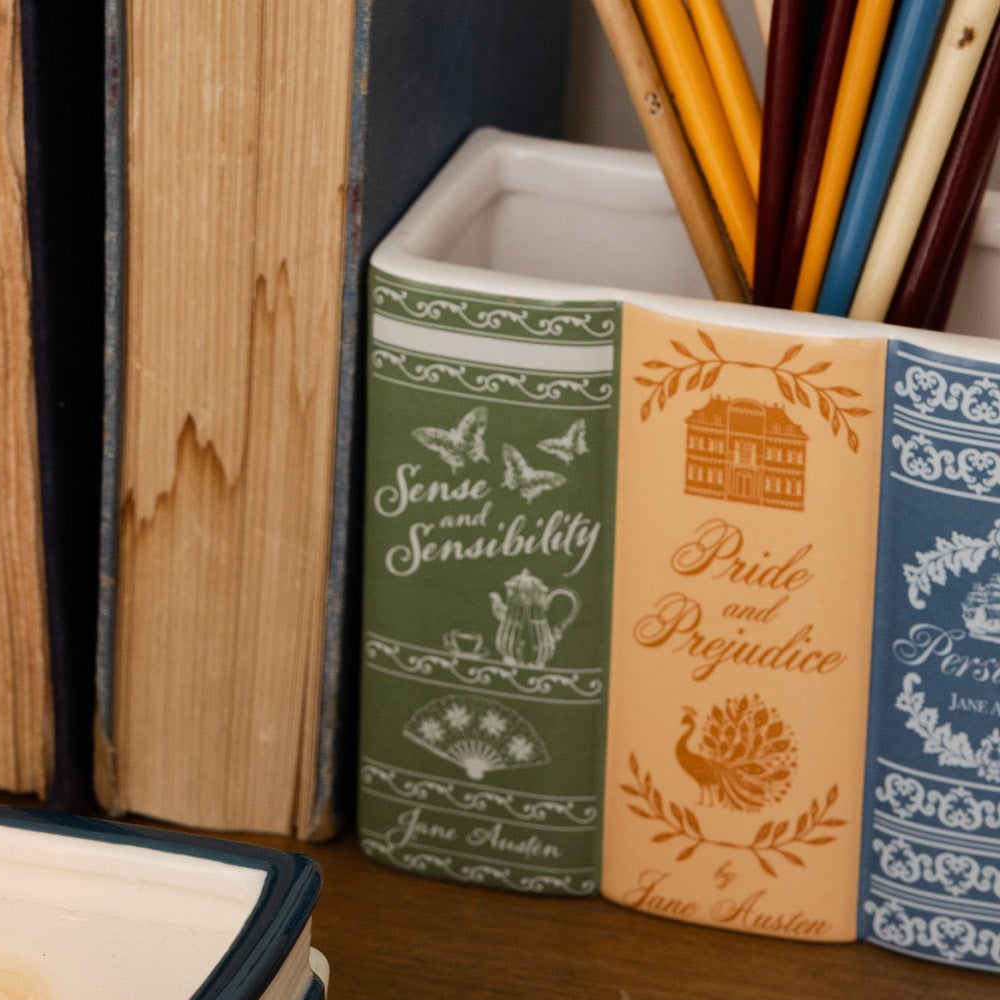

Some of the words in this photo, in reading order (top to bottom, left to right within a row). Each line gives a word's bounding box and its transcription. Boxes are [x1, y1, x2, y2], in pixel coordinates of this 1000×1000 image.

[374, 463, 492, 518] Sense
[439, 502, 492, 529] and
[385, 510, 600, 577] Sensibility
[670, 518, 815, 592] Pride
[633, 592, 848, 682] Prejudice
[722, 595, 789, 624] and
[384, 807, 457, 852] Jane
[466, 822, 561, 858] Austen
[623, 869, 698, 915] Jane
[710, 888, 828, 936] Austen
